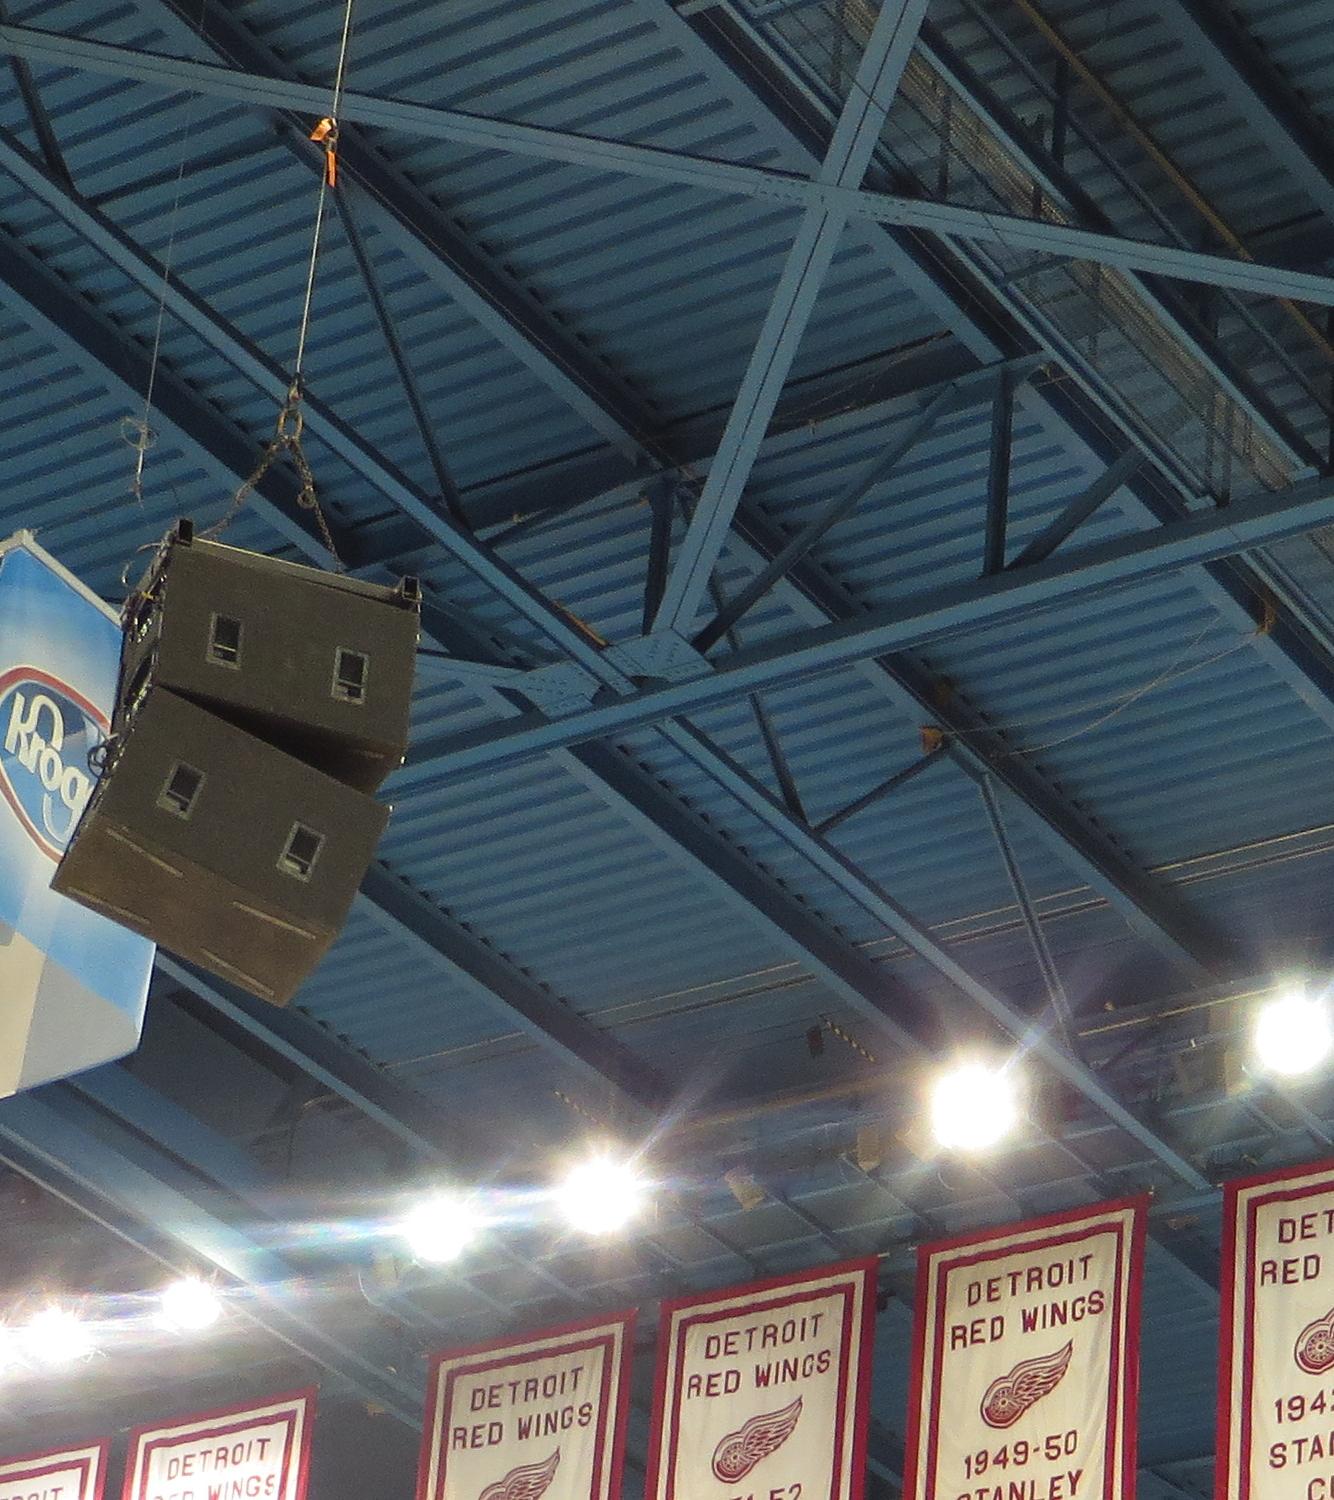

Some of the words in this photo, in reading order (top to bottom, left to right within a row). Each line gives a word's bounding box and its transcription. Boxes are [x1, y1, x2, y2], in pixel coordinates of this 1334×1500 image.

[4, 691, 94, 843] Krog
[968, 1255, 1093, 1307] DETROIT
[1260, 1255, 1320, 1286] RED
[705, 1313, 823, 1359] DETROIT
[951, 1316, 1005, 1350] RED
[1022, 1291, 1105, 1333] WINGS
[470, 1367, 584, 1411] DETROIT
[688, 1370, 740, 1399] RED
[755, 1350, 831, 1387] WINGS
[453, 1422, 502, 1449] RED
[518, 1402, 592, 1440] WINGS
[167, 1438, 271, 1480] DETROIT
[964, 1430, 1078, 1479] 1949-50
